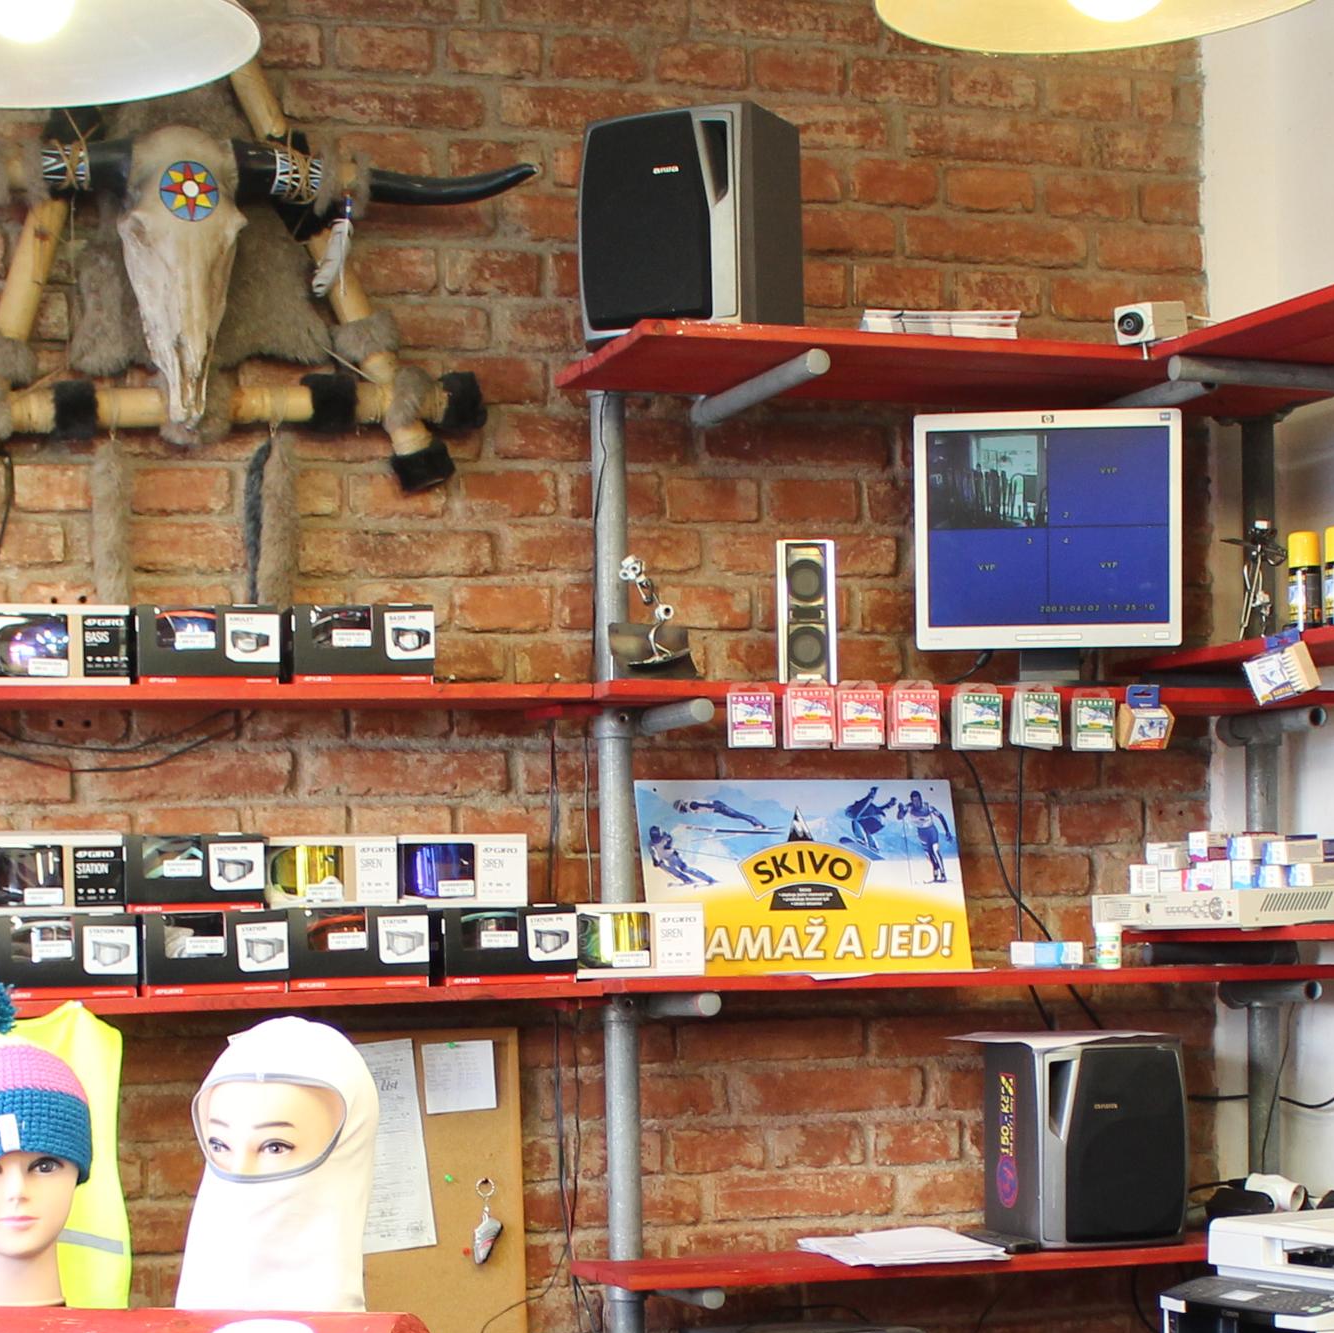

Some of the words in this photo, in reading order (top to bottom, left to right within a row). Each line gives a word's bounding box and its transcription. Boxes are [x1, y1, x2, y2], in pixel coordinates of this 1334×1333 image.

[97, 618, 125, 627] GIRO
[84, 631, 110, 643] BASIS
[92, 850, 114, 859] GIRO
[75, 862, 109, 875] STATION
[360, 858, 383, 869] SIREN
[482, 858, 504, 869] SIREN
[752, 849, 853, 885] SKIVO
[660, 927, 683, 939] SIREN
[705, 916, 827, 961] AMAŽ
[834, 925, 866, 960] A
[871, 914, 955, 960] JEĎ!
